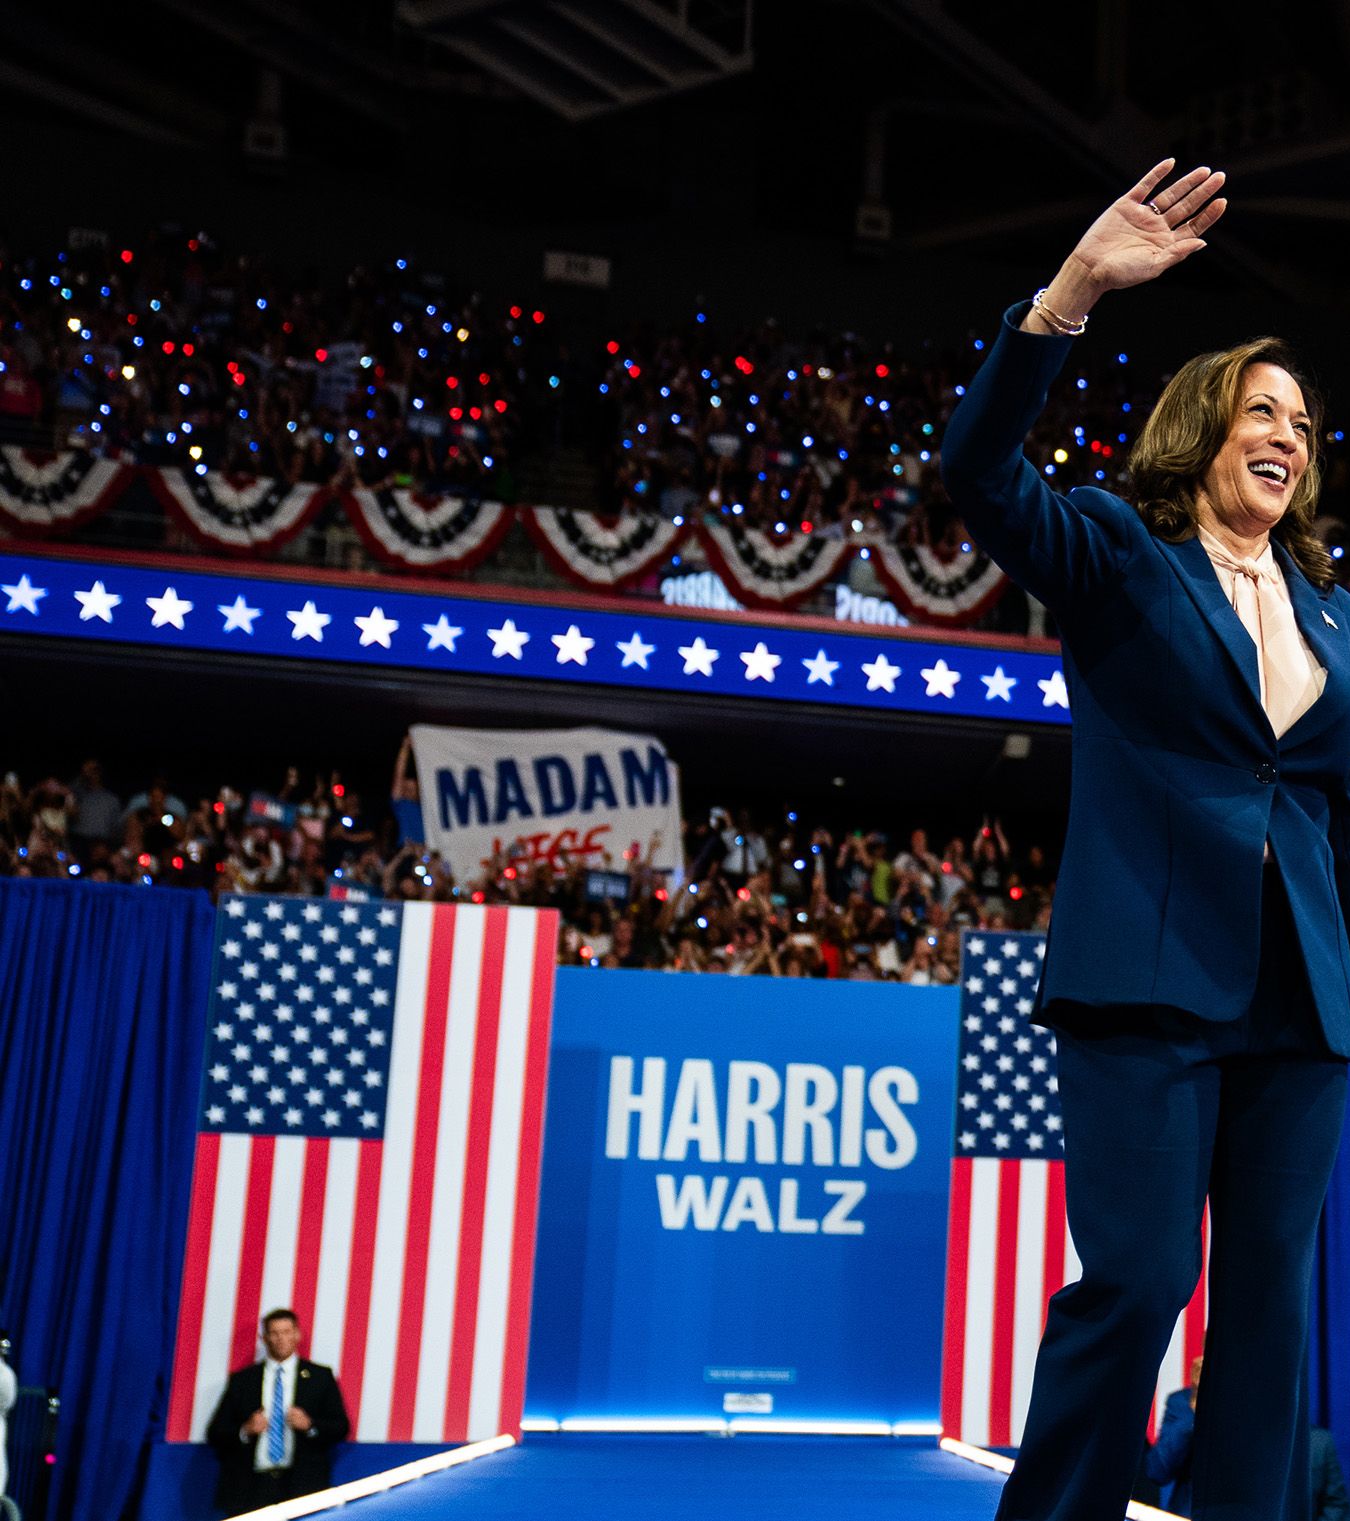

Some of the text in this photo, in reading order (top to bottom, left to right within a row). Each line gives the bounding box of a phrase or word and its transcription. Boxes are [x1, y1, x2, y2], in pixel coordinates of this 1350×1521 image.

[435, 744, 671, 831] MADAM
[605, 1055, 919, 1170] HARRIS
[656, 1173, 868, 1235] WALZ
